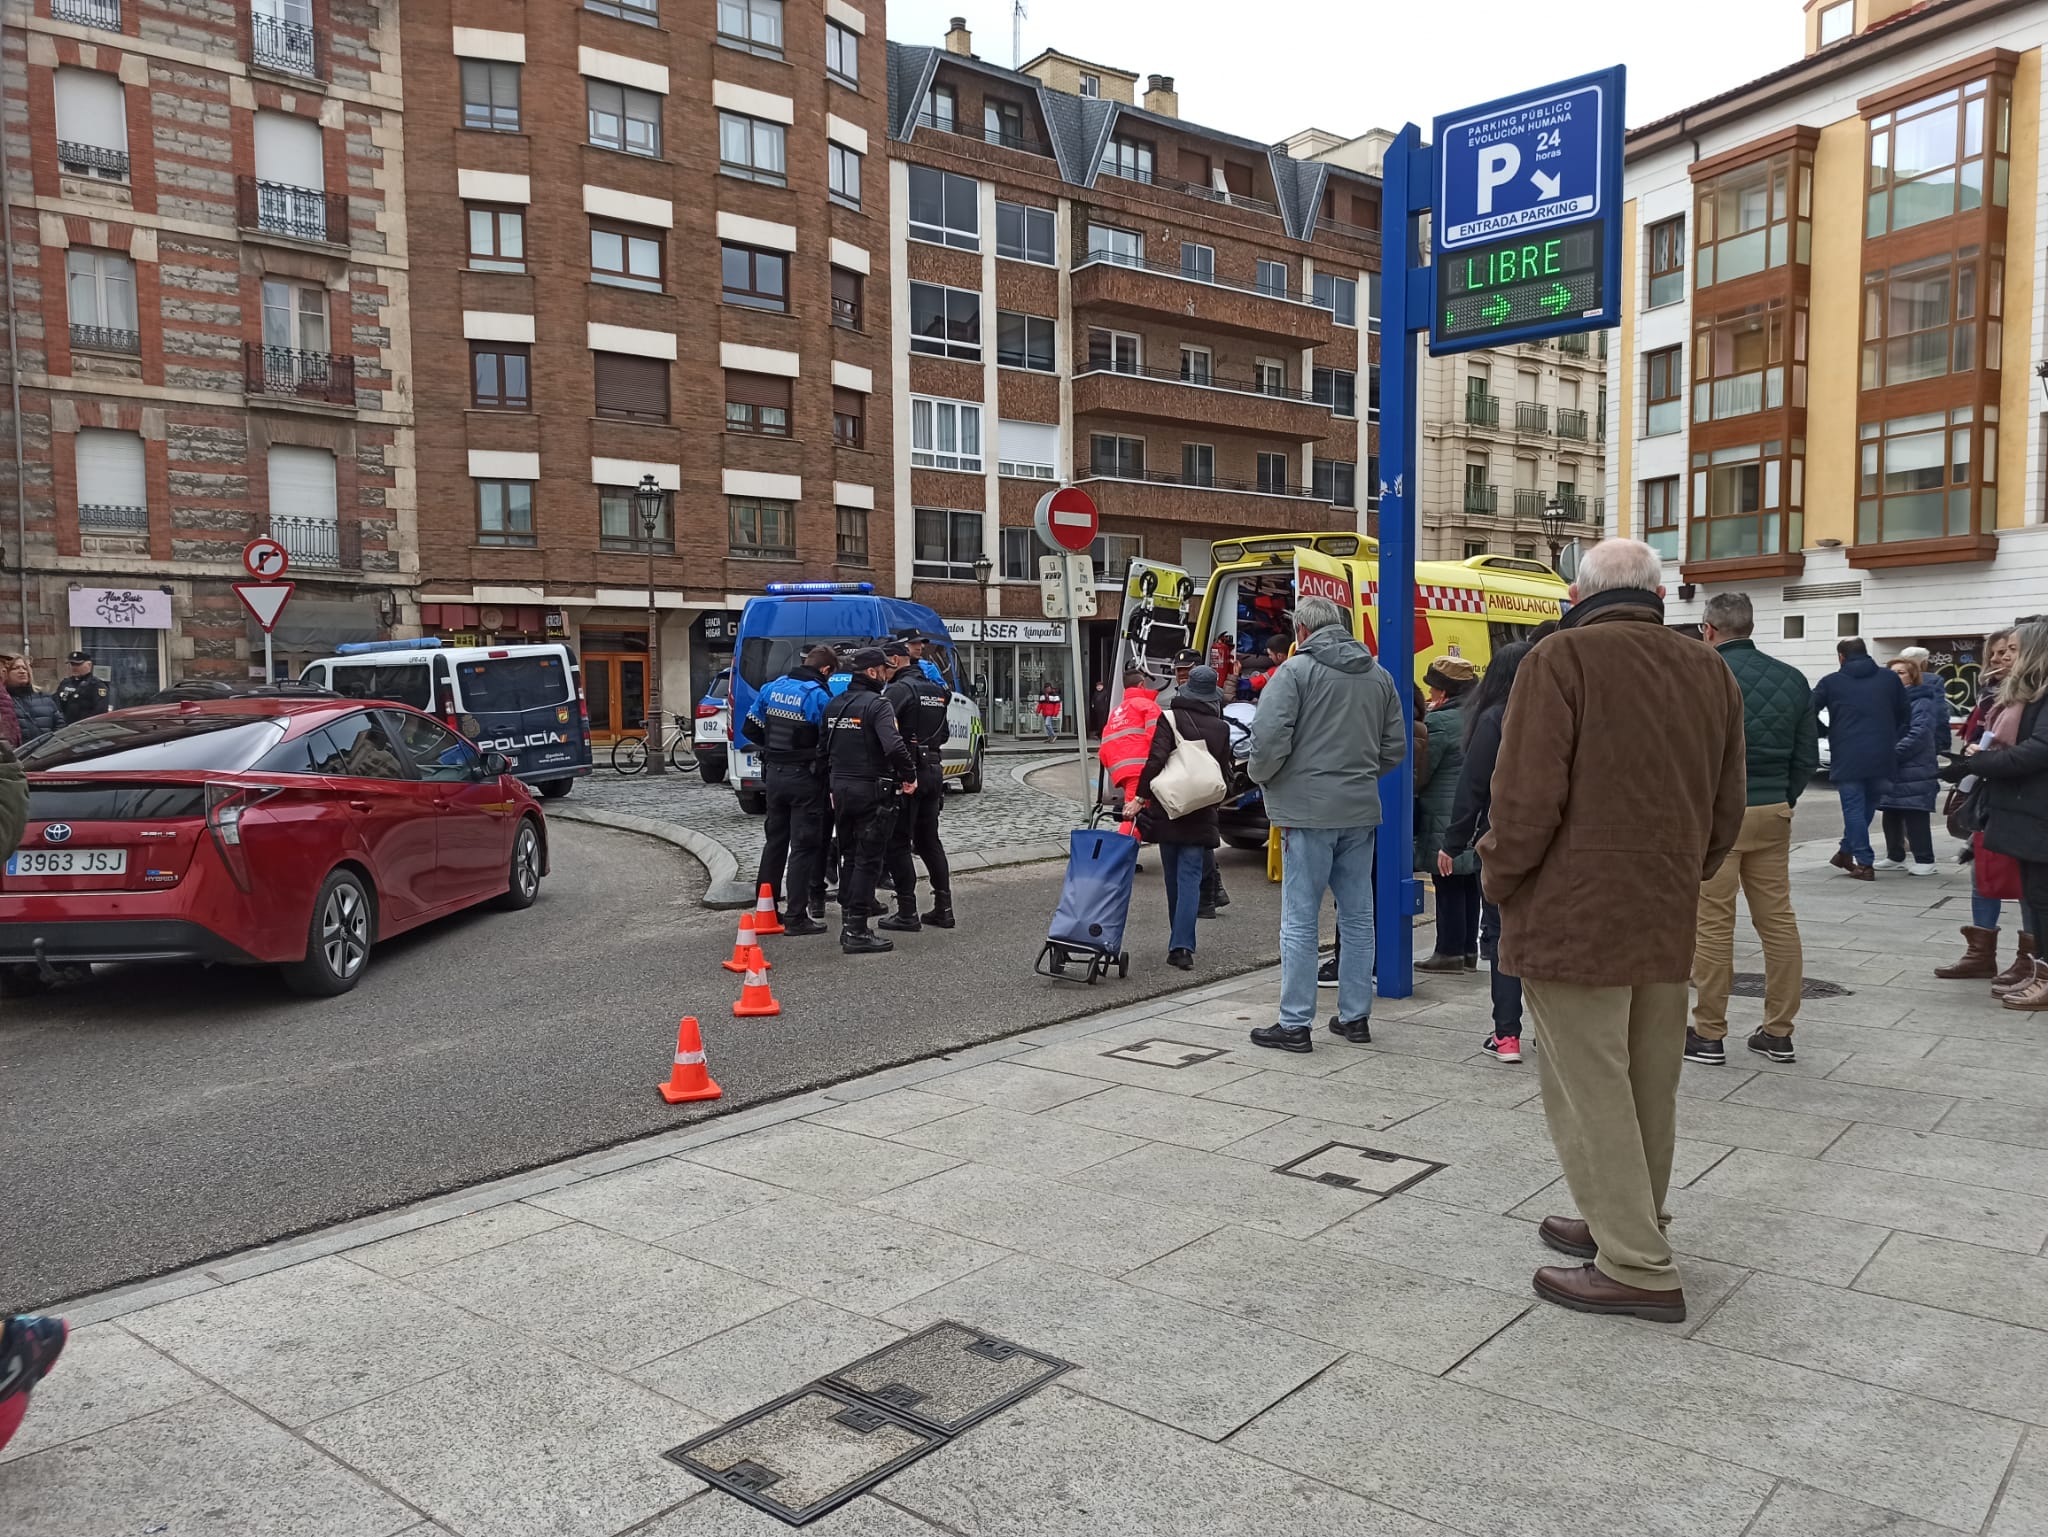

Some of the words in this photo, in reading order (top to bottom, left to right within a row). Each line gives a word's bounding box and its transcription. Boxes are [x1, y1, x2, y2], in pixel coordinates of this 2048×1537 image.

[1468, 116, 1517, 137] PARKING
[1521, 101, 1572, 122] PÚBLICO
[1468, 124, 1525, 148] EVOLUCIÓN
[1527, 112, 1572, 132] HUMANA
[1535, 128, 1562, 151] 24
[1535, 149, 1562, 162] horas
[1477, 142, 1521, 216] P
[1460, 213, 1518, 237] ENTRADA
[1520, 200, 1578, 220] PARKING
[1467, 239, 1562, 290] LIBRE
[1488, 594, 1560, 616] AMBULANCIA
[705, 627, 721, 639] HOGAR
[971, 623, 1018, 638] LASER
[769, 691, 802, 708] POLICÍA
[703, 720, 718, 732] 092
[477, 729, 561, 752] POLICÍA
[21, 853, 74, 872] 3963
[82, 852, 122, 872] JSJ
